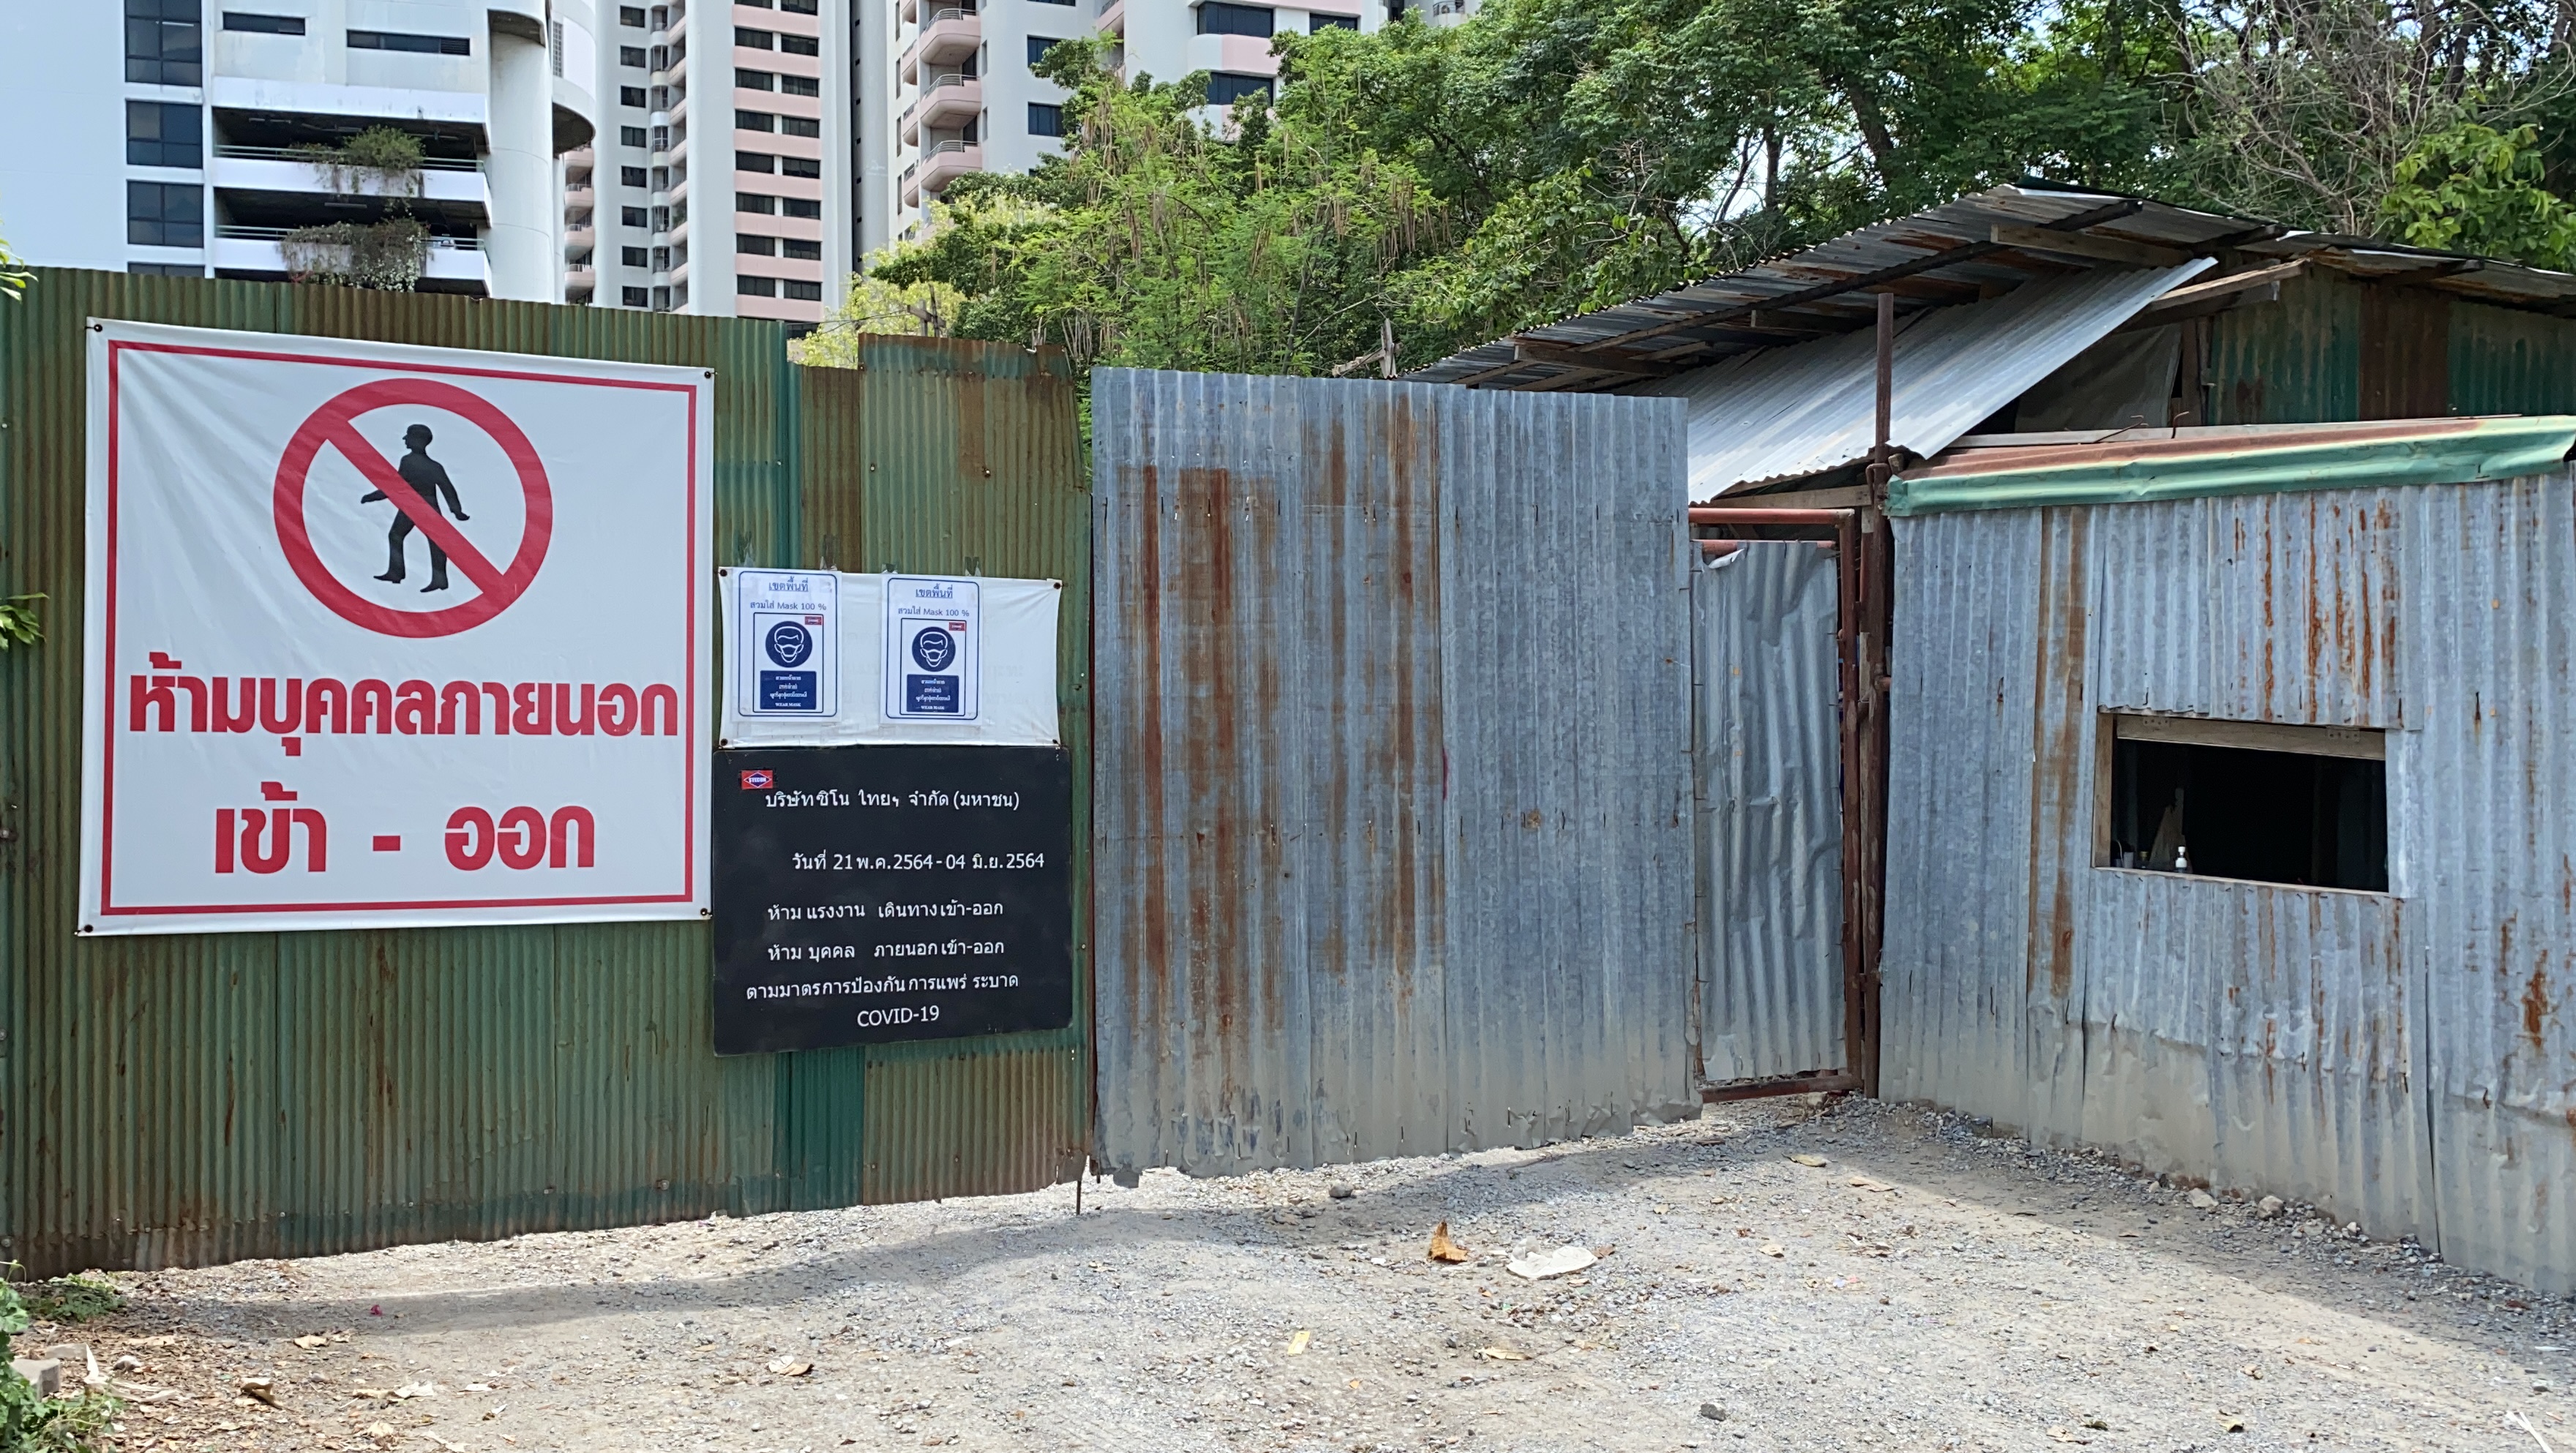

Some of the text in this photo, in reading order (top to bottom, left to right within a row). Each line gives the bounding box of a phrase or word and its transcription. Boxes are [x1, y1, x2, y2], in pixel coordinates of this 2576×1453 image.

[768, 576, 809, 592] เขตพื้นที่
[916, 583, 954, 599] เขตพื้นที่
[750, 600, 827, 611] สวมใส่ Mask 100 %
[898, 606, 921, 615] สวมใส่
[924, 608, 943, 617] Mask
[946, 609, 959, 617] 100
[130, 652, 678, 756] ห้ามบุคคลภายนอก
[215, 781, 327, 874] เข้า
[444, 806, 595, 871] ออก
[792, 849, 826, 870] วันที่
[768, 904, 801, 920] ห้าม
[806, 904, 866, 920] แรงงาน
[768, 944, 801, 961] ห้าม
[808, 945, 855, 963] บุคคล
[973, 975, 1019, 988] ระบาด
[857, 1005, 940, 1027] COVID-19
